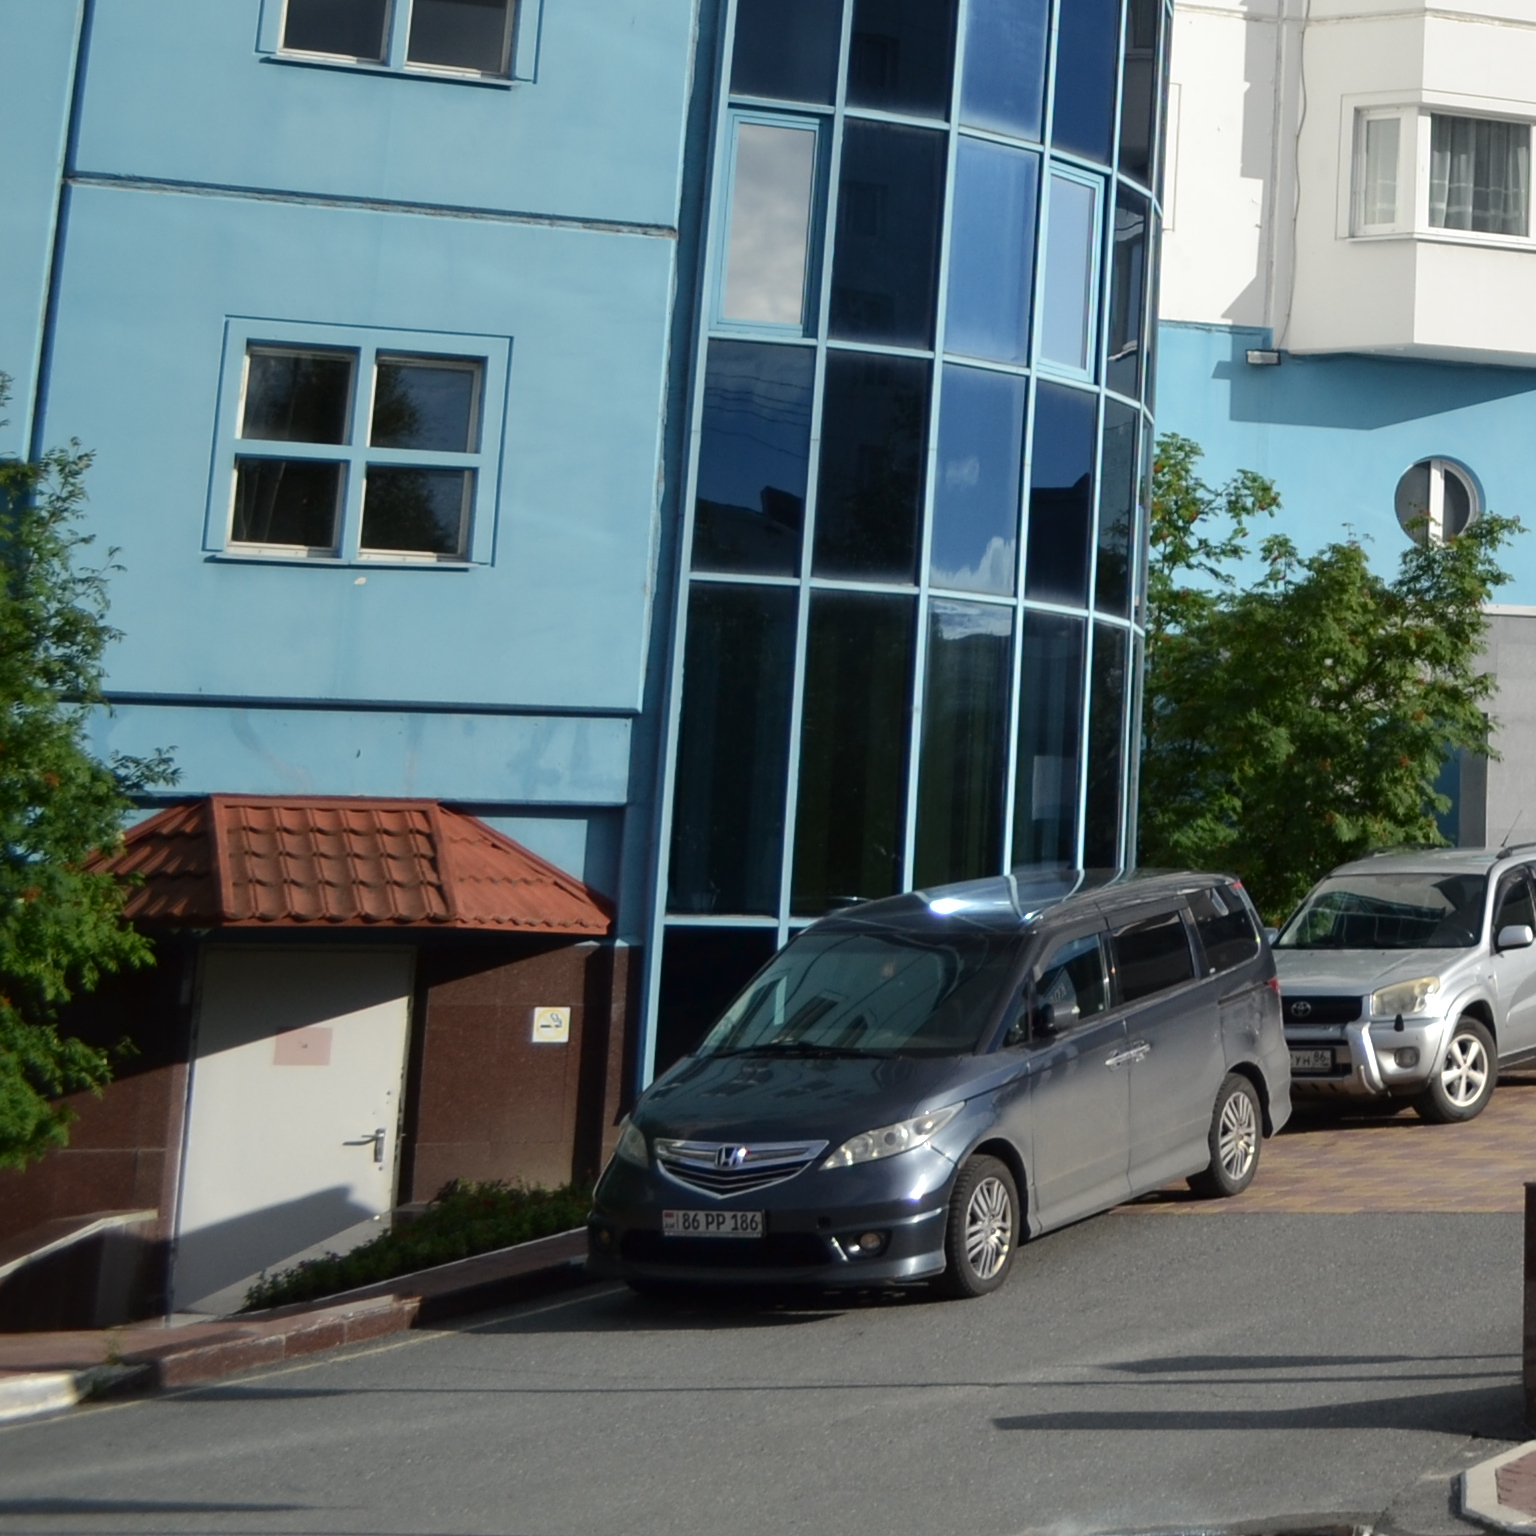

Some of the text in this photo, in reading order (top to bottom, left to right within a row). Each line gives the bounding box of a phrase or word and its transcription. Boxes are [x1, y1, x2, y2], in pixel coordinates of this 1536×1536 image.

[682, 1212, 759, 1232] 86 PP 186
